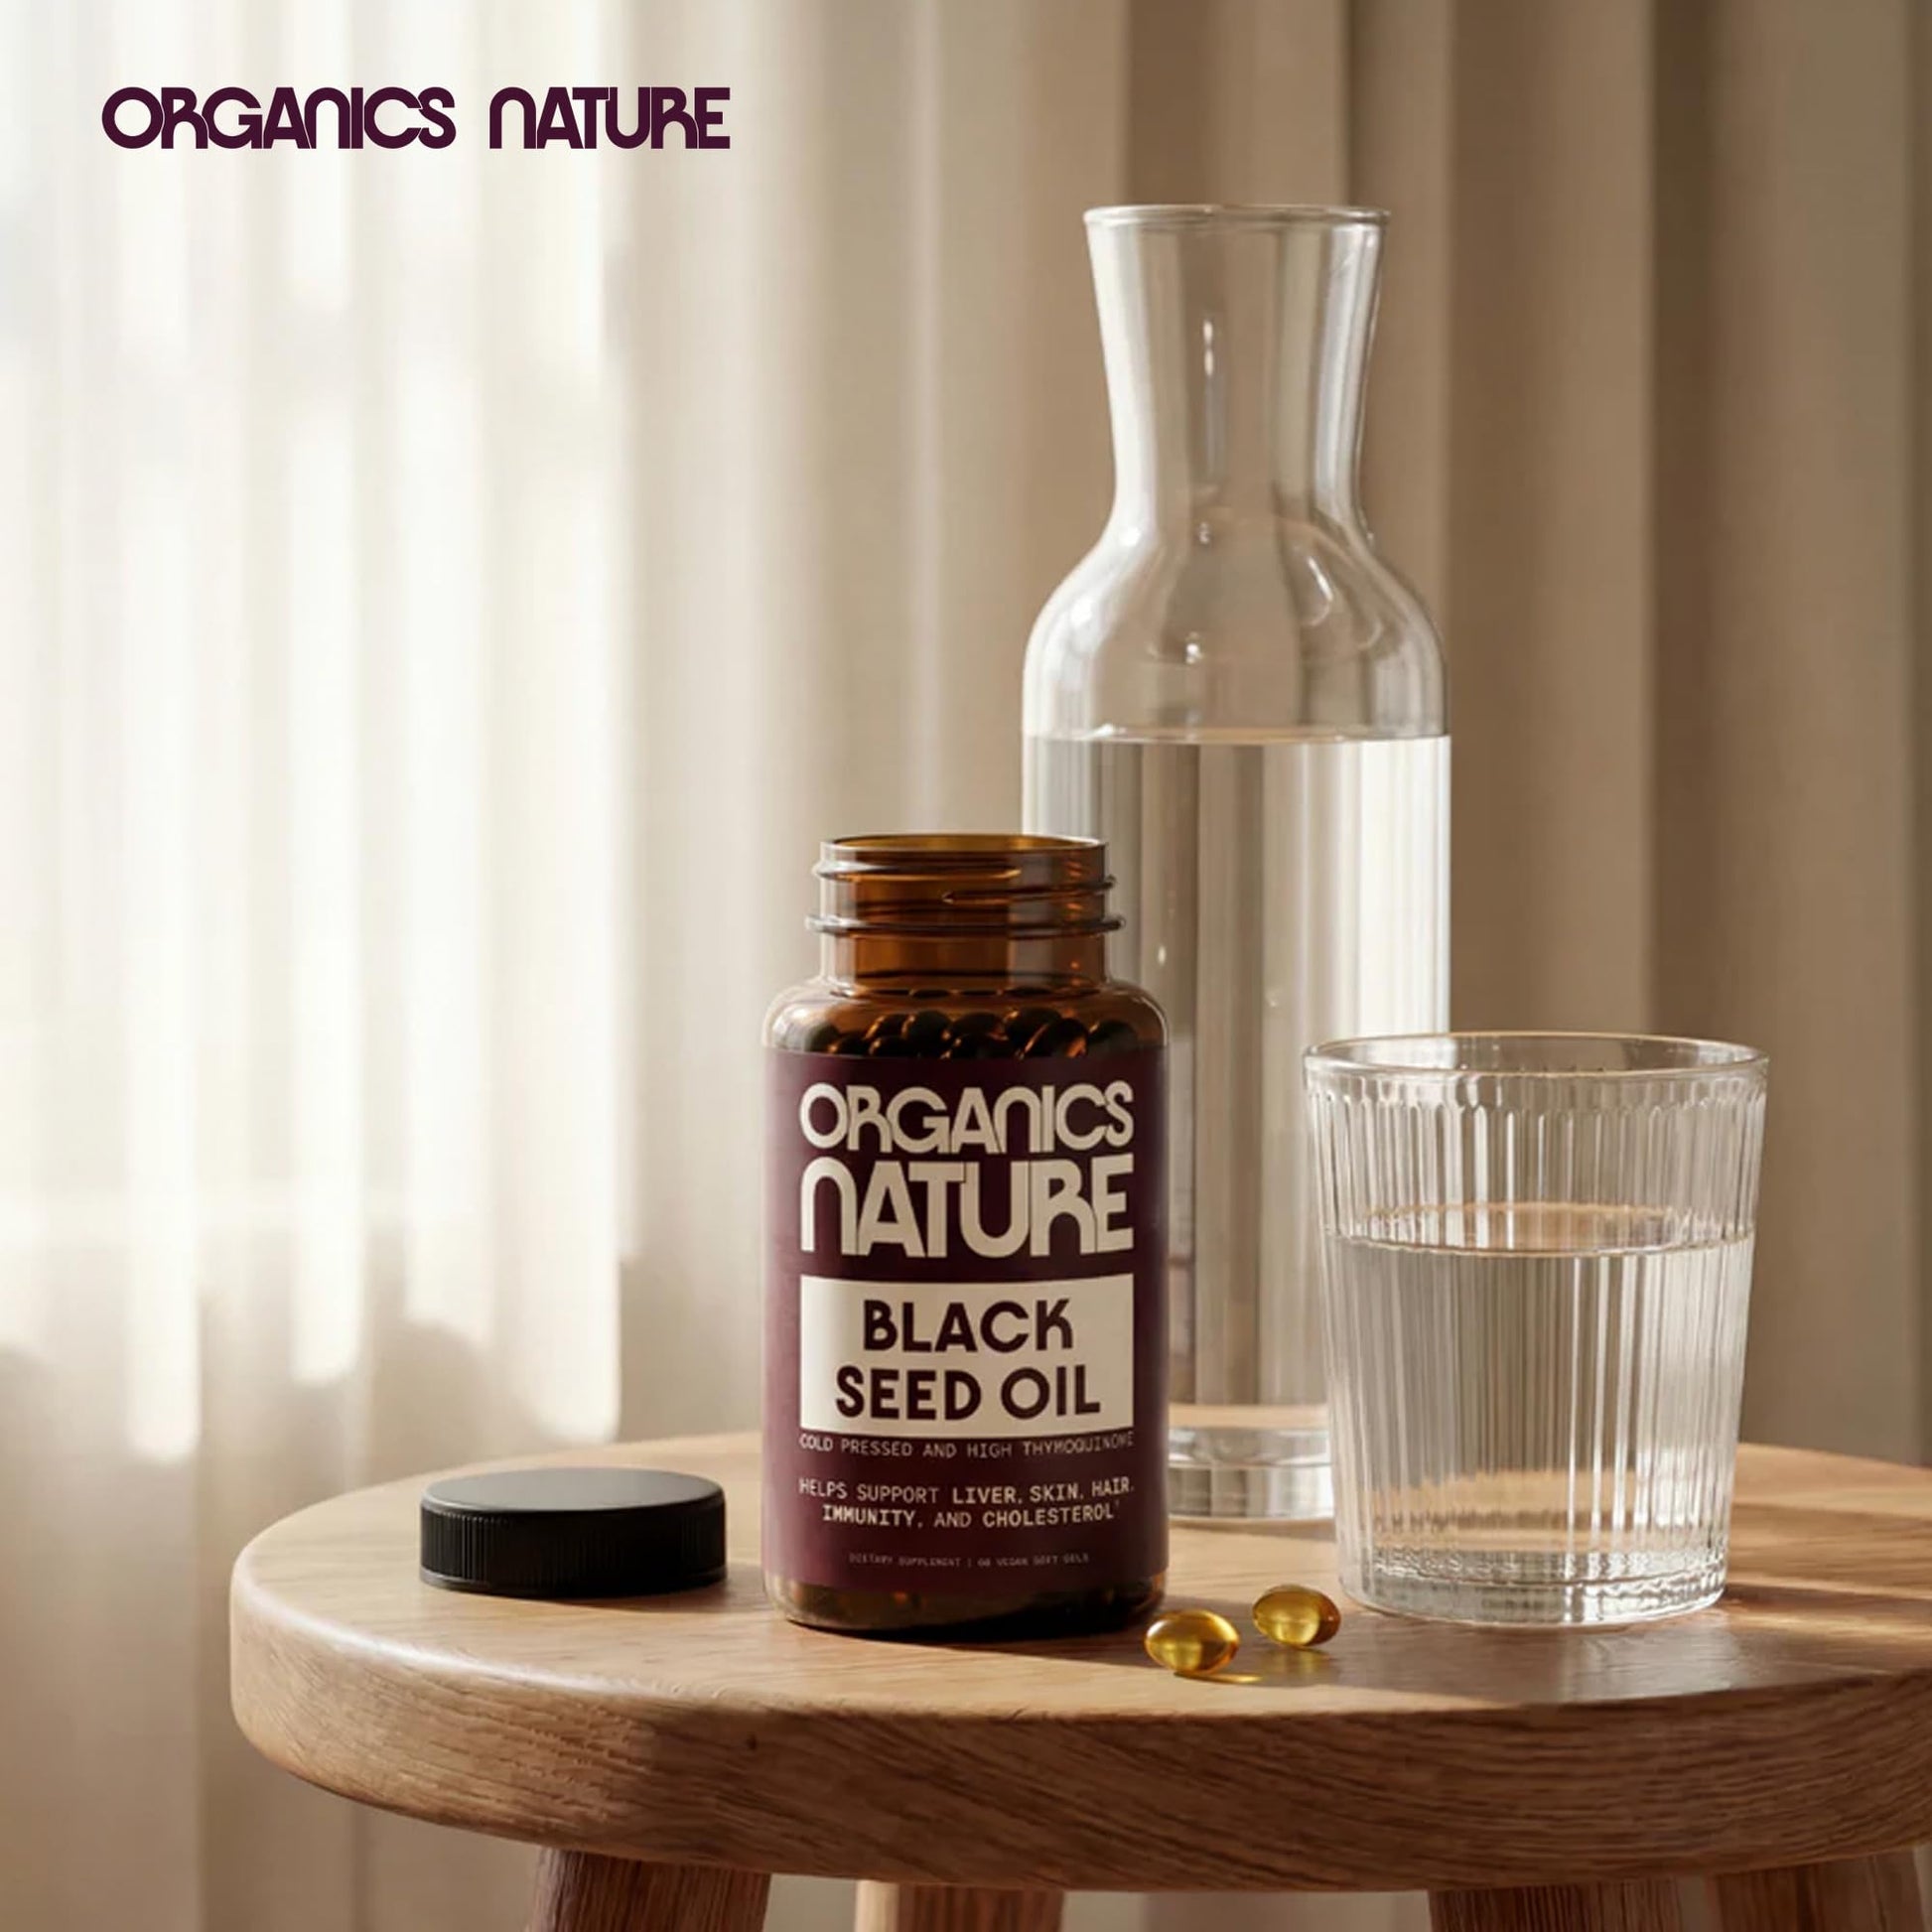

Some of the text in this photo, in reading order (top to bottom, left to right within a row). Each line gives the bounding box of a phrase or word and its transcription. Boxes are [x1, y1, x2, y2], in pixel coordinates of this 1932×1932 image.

[800, 1080, 1134, 1154] ORGANICS
[800, 1154, 1134, 1258] NATURE
[863, 1299, 1073, 1352] BLACK
[836, 1365, 1100, 1421] SEED OIL
[798, 1433, 834, 1452] COLD
[841, 1438, 913, 1457] PRESSED
[922, 1442, 958, 1459] AND
[966, 1442, 1013, 1459] HIGH
[798, 1477, 848, 1500] HELPS
[857, 1482, 939, 1505] SUPPORT
[933, 1511, 972, 1529] AND
